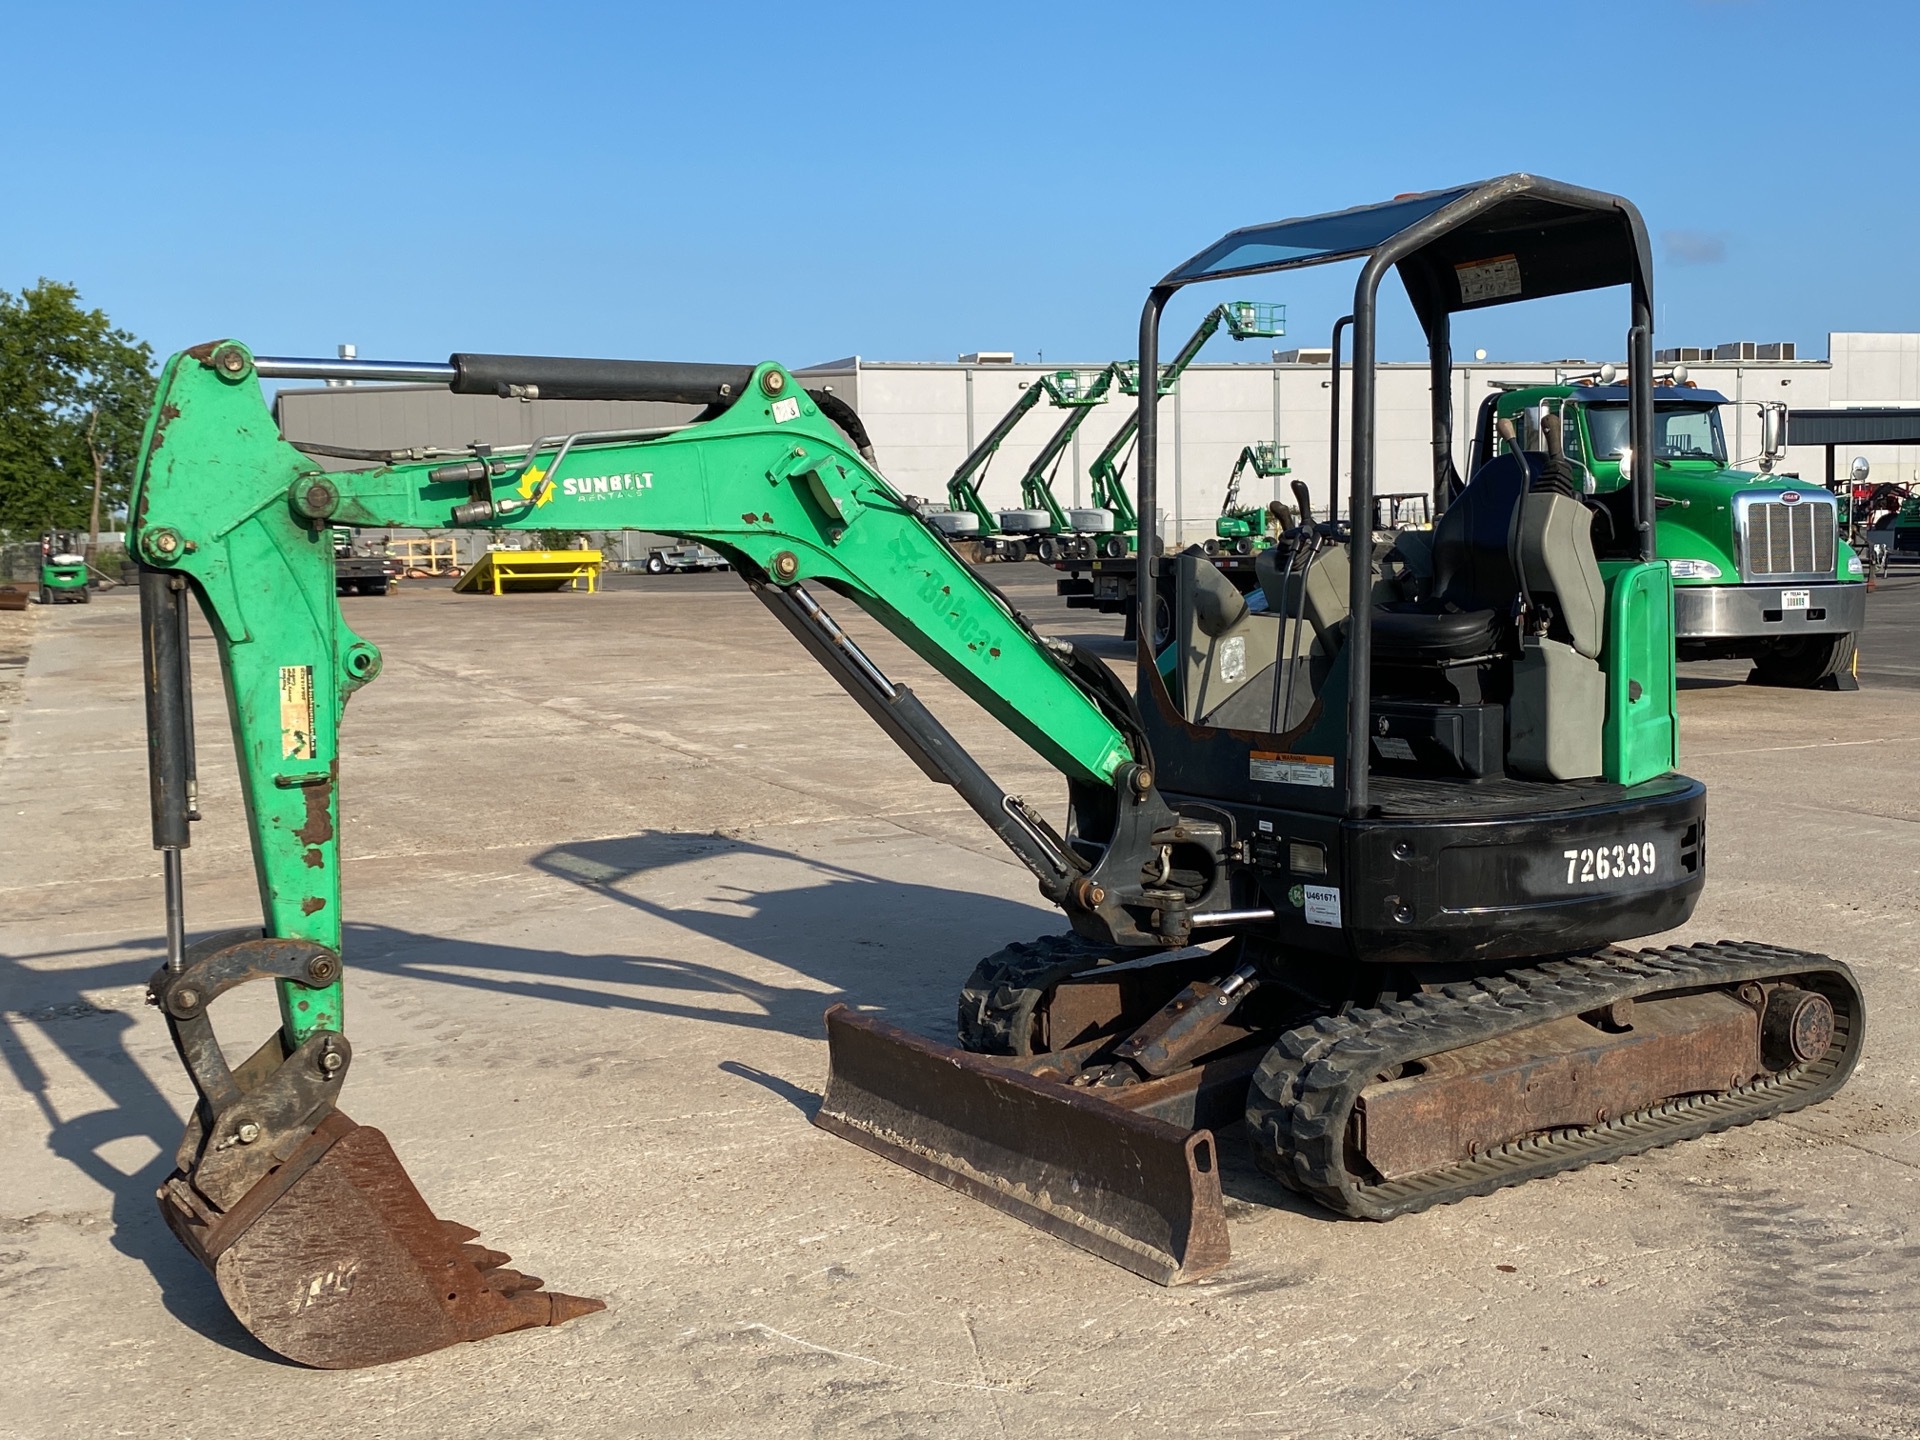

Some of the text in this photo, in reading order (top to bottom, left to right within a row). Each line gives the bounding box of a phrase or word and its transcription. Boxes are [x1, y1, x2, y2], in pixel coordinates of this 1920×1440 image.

[563, 472, 654, 495] SUNBELT
[916, 568, 1003, 665] Bobcat
[1281, 754, 1306, 763] WARNING
[1563, 841, 1656, 885] 726339
